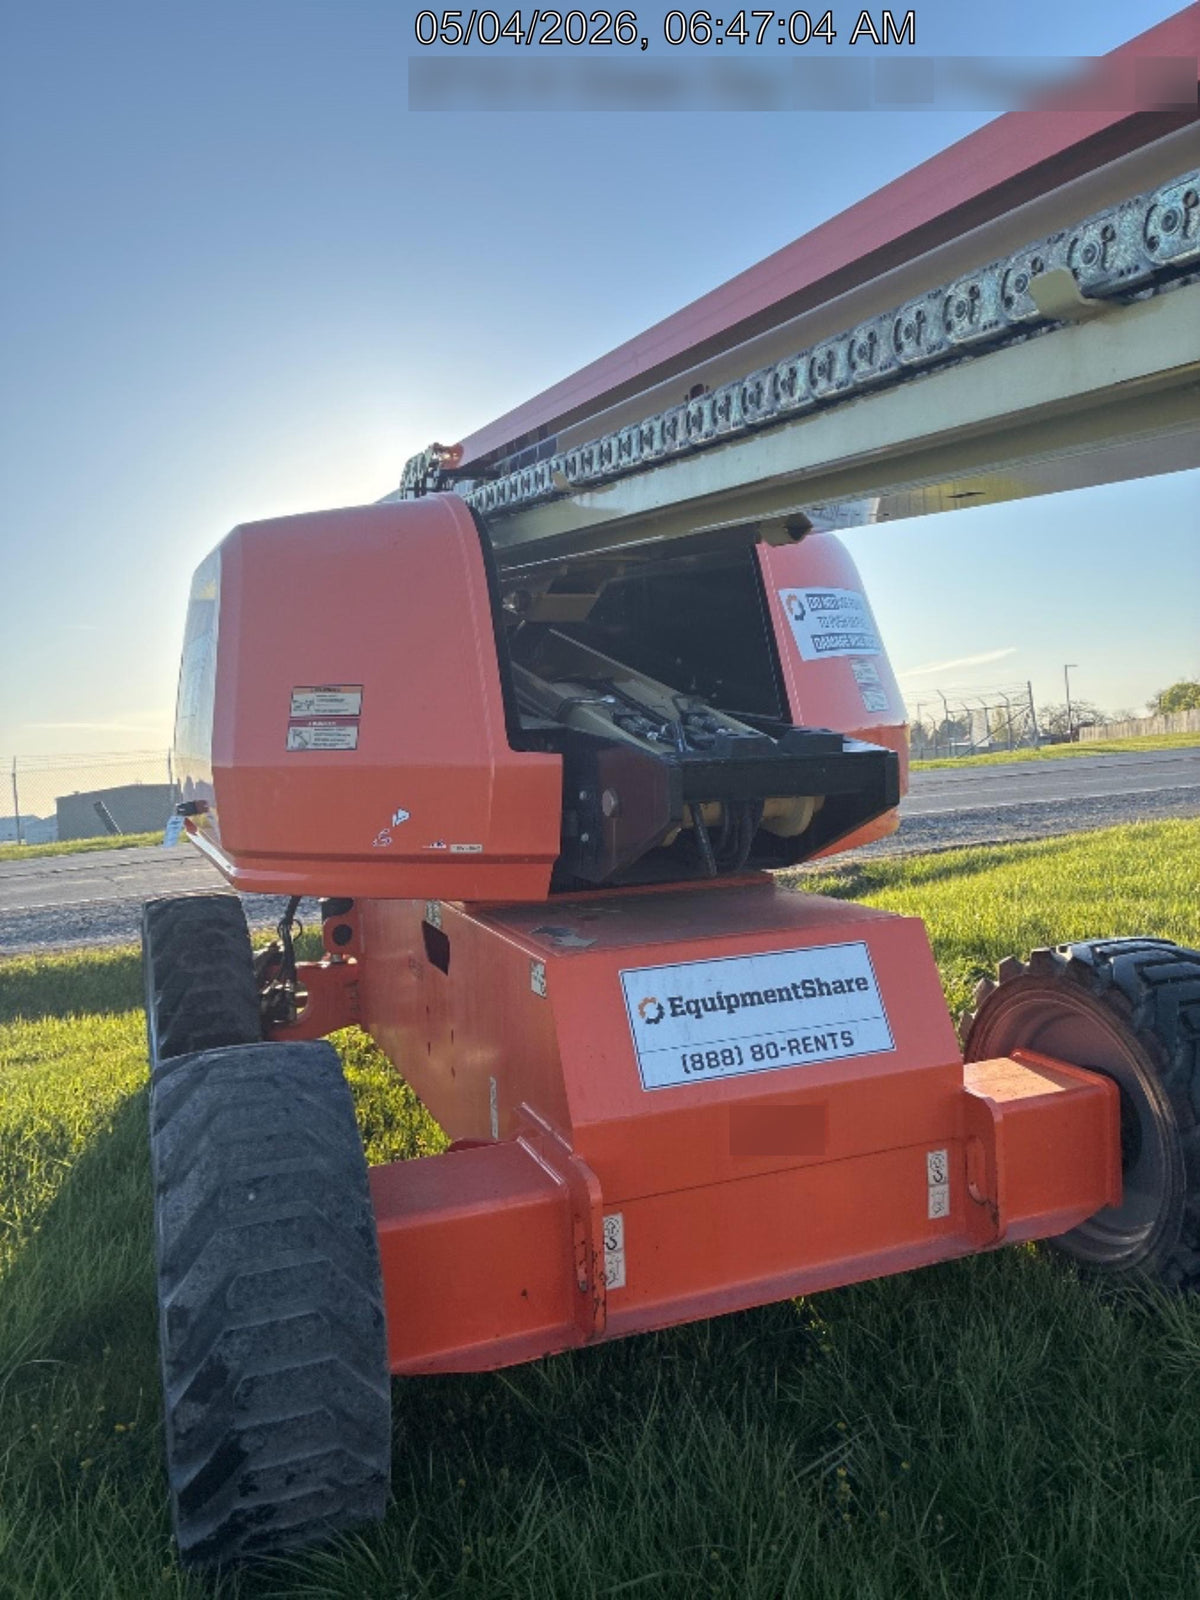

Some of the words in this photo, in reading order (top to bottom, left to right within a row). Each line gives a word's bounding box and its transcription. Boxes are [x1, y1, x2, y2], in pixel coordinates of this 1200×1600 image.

[667, 976, 870, 1019] EquipmentShare
[682, 1046, 744, 1074] (888)
[751, 1030, 855, 1062] 80-RENTS
